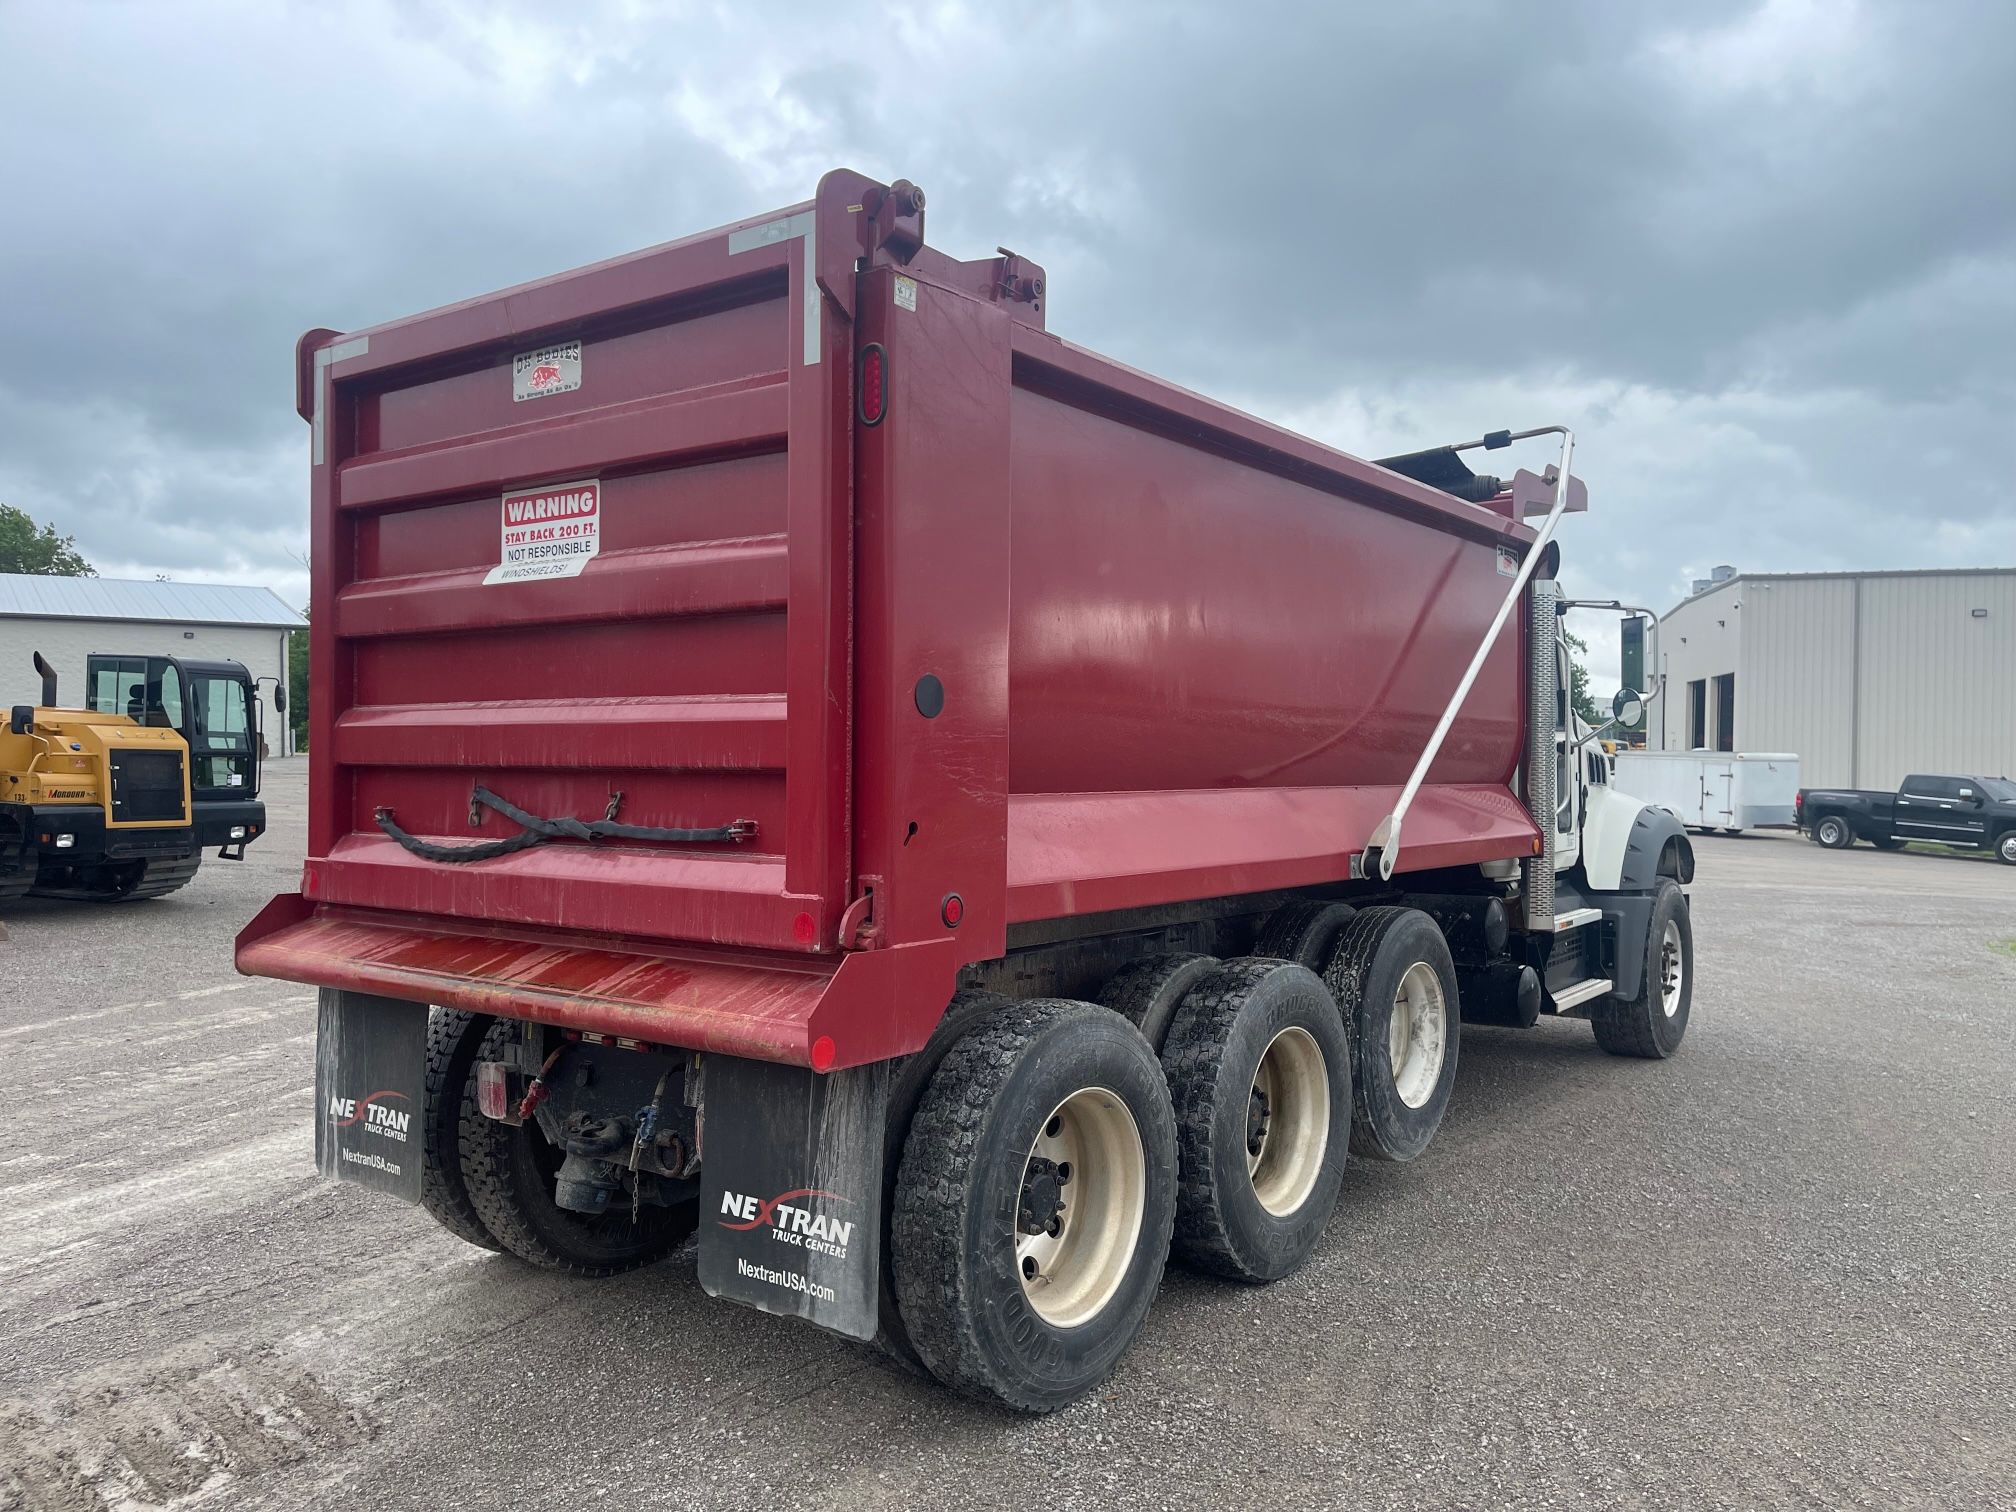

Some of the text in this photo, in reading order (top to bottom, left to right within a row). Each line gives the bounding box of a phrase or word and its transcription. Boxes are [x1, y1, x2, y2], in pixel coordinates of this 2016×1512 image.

[536, 344, 579, 363] BODIES
[507, 492, 593, 522] WARNING
[505, 523, 596, 544] STAY BACK 200 FT.
[508, 541, 591, 561] NOT RESPONSIBLE
[501, 564, 569, 579] WINDSHIELDS!
[329, 1096, 410, 1132] NEXTRAN
[364, 1123, 407, 1142] TRUCK CENTERS
[342, 1147, 401, 1176] NextranUSA.com
[721, 1191, 852, 1246] NEXTRAN
[772, 1229, 847, 1259] TRUCK CENTERS
[738, 1258, 835, 1303] NextranUSA.com
